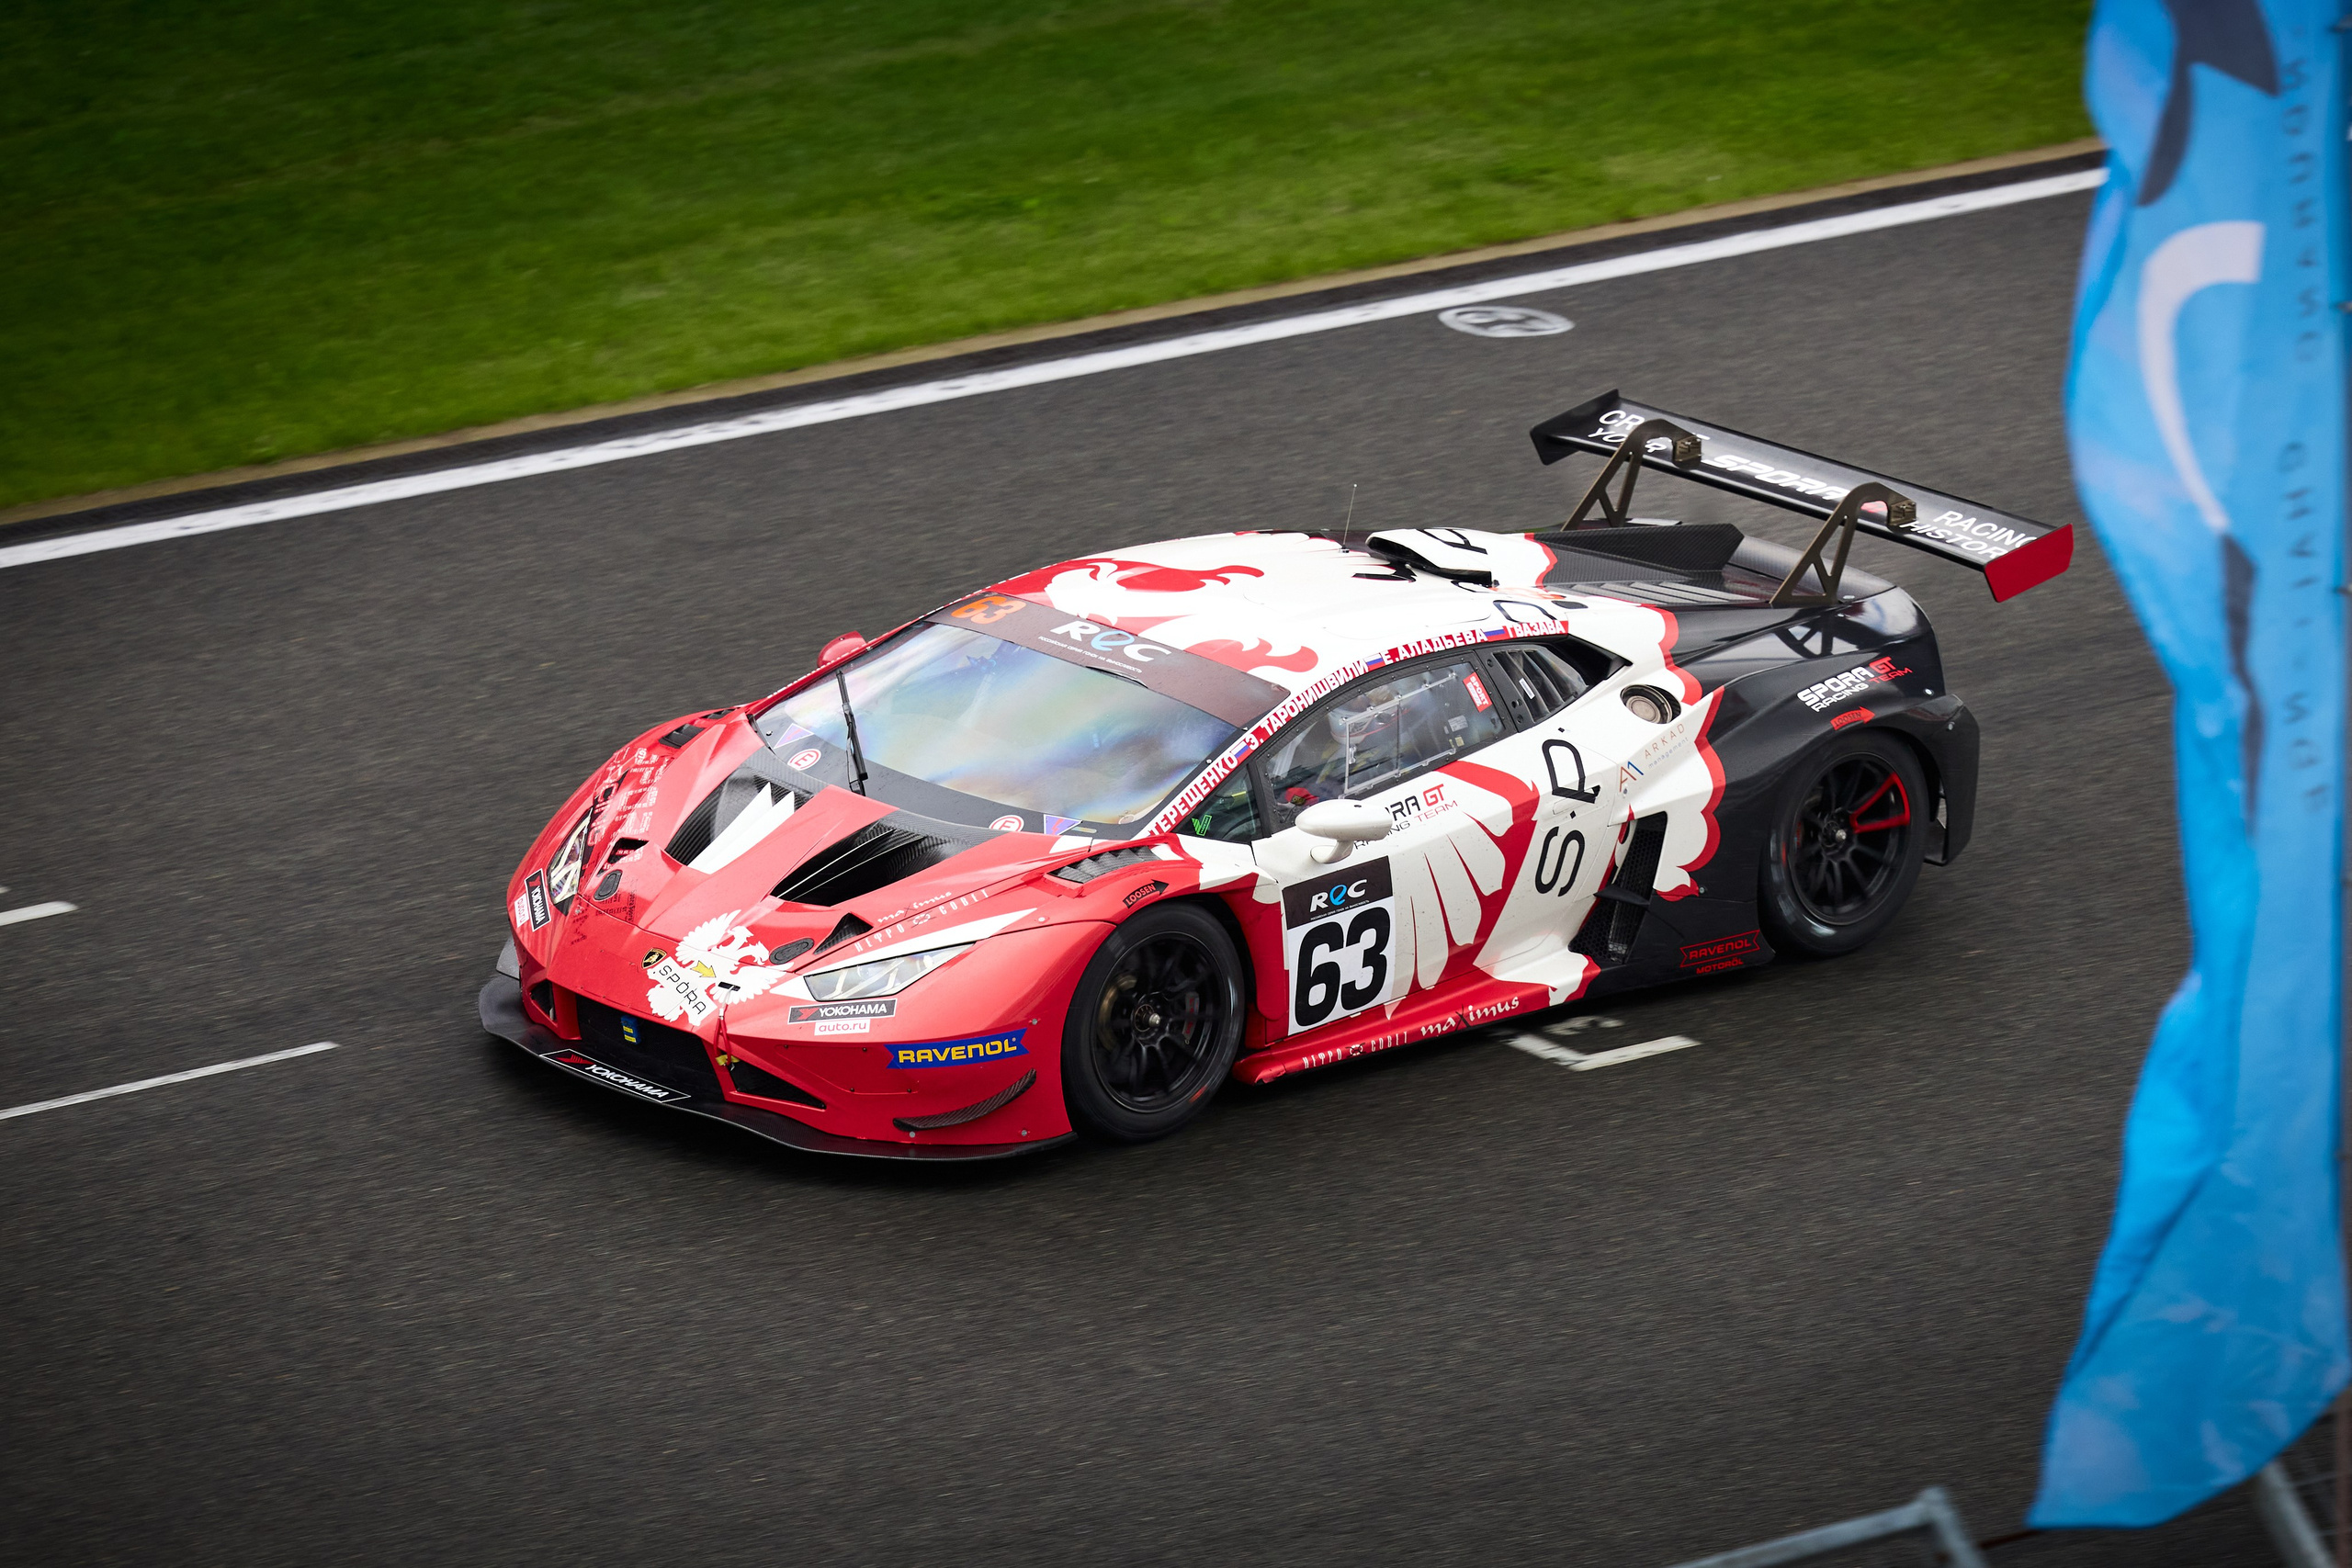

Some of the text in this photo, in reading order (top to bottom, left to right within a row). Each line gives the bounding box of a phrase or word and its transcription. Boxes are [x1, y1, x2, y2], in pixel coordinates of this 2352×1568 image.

[1701, 454, 1851, 501] SPORA
[950, 596, 1027, 625] 63
[1261, 660, 1369, 737] ТАРОНИШВИЛИ
[1503, 620, 1565, 639] ГВАЗАВА
[1470, 676, 1488, 705] SPORT
[1797, 656, 1897, 706] SPORA GT
[1811, 667, 1913, 712] RACING TEAM
[1644, 723, 1686, 760] ARKAD
[1647, 737, 1690, 769] management
[1414, 800, 1458, 822] TEAM
[1423, 784, 1444, 807] GT
[531, 886, 546, 925] YOKOHAMA
[1125, 884, 1157, 906] LOOSEN
[854, 889, 989, 953] НЕФРО СОВЕТ
[1689, 939, 1752, 960] RAVENOL
[1295, 907, 1391, 1027] 63
[819, 1004, 887, 1018] YOKOHAMA
[819, 1020, 866, 1032] auto.ru
[898, 1038, 1017, 1064] RAVENOL
[585, 1064, 669, 1099] YOKOHAMA
